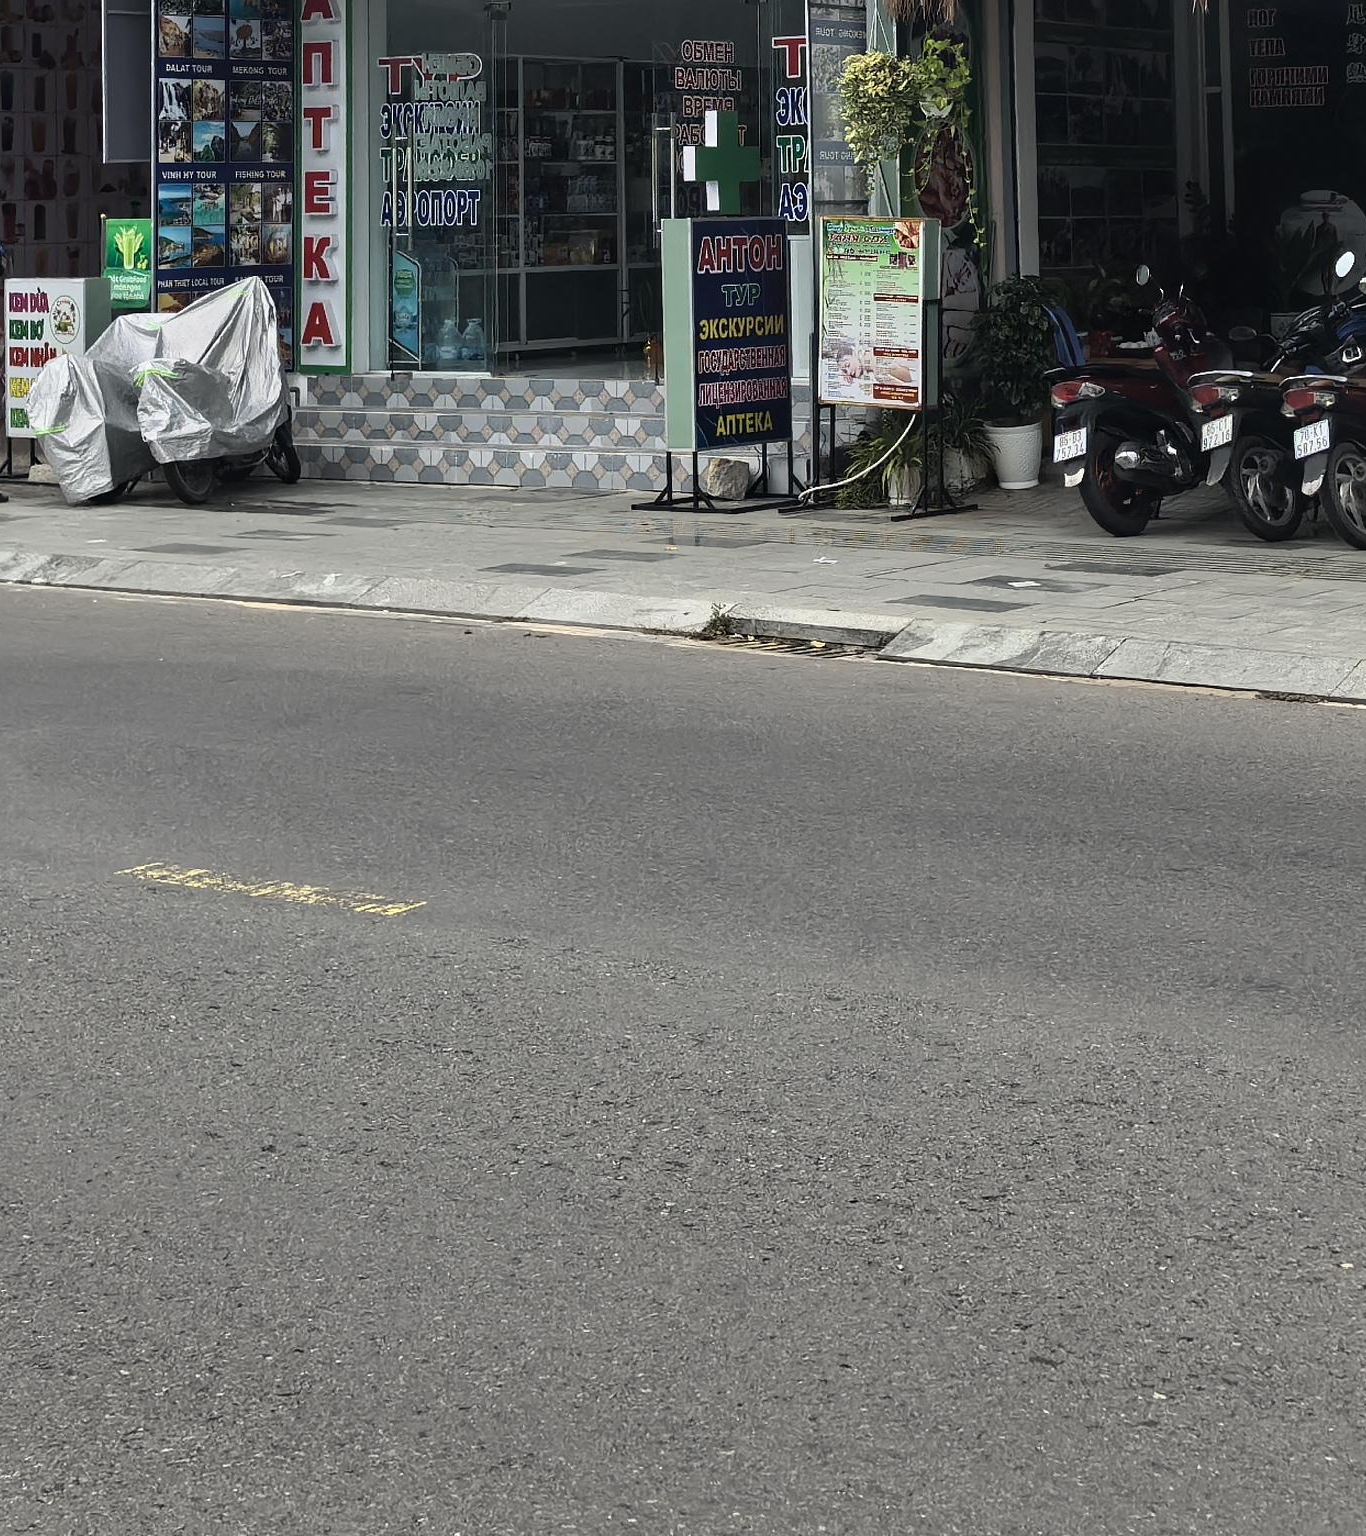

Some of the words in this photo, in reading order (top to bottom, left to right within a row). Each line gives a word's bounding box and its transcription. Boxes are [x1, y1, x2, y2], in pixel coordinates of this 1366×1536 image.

[682, 40, 735, 63] ОБМЕН
[166, 64, 190, 72] DALAT
[192, 64, 213, 73] TOUR
[233, 66, 264, 75] MEKONG
[268, 67, 288, 76] TOUR
[675, 66, 742, 90] ВАЛЮТЫ
[197, 171, 217, 179] TOUR
[235, 170, 265, 178] FISHING
[267, 170, 286, 178] TOUR
[697, 234, 783, 274] АНТОН
[721, 284, 761, 307] ТУР
[699, 314, 784, 340] ЭКСКУРСИИ
[697, 345, 785, 375] ГОСУДАРСТВЕННАЯ
[698, 377, 787, 409] ЛИЦЕНЗИРОВАННАЯ
[715, 410, 773, 437] АПТЕКА
